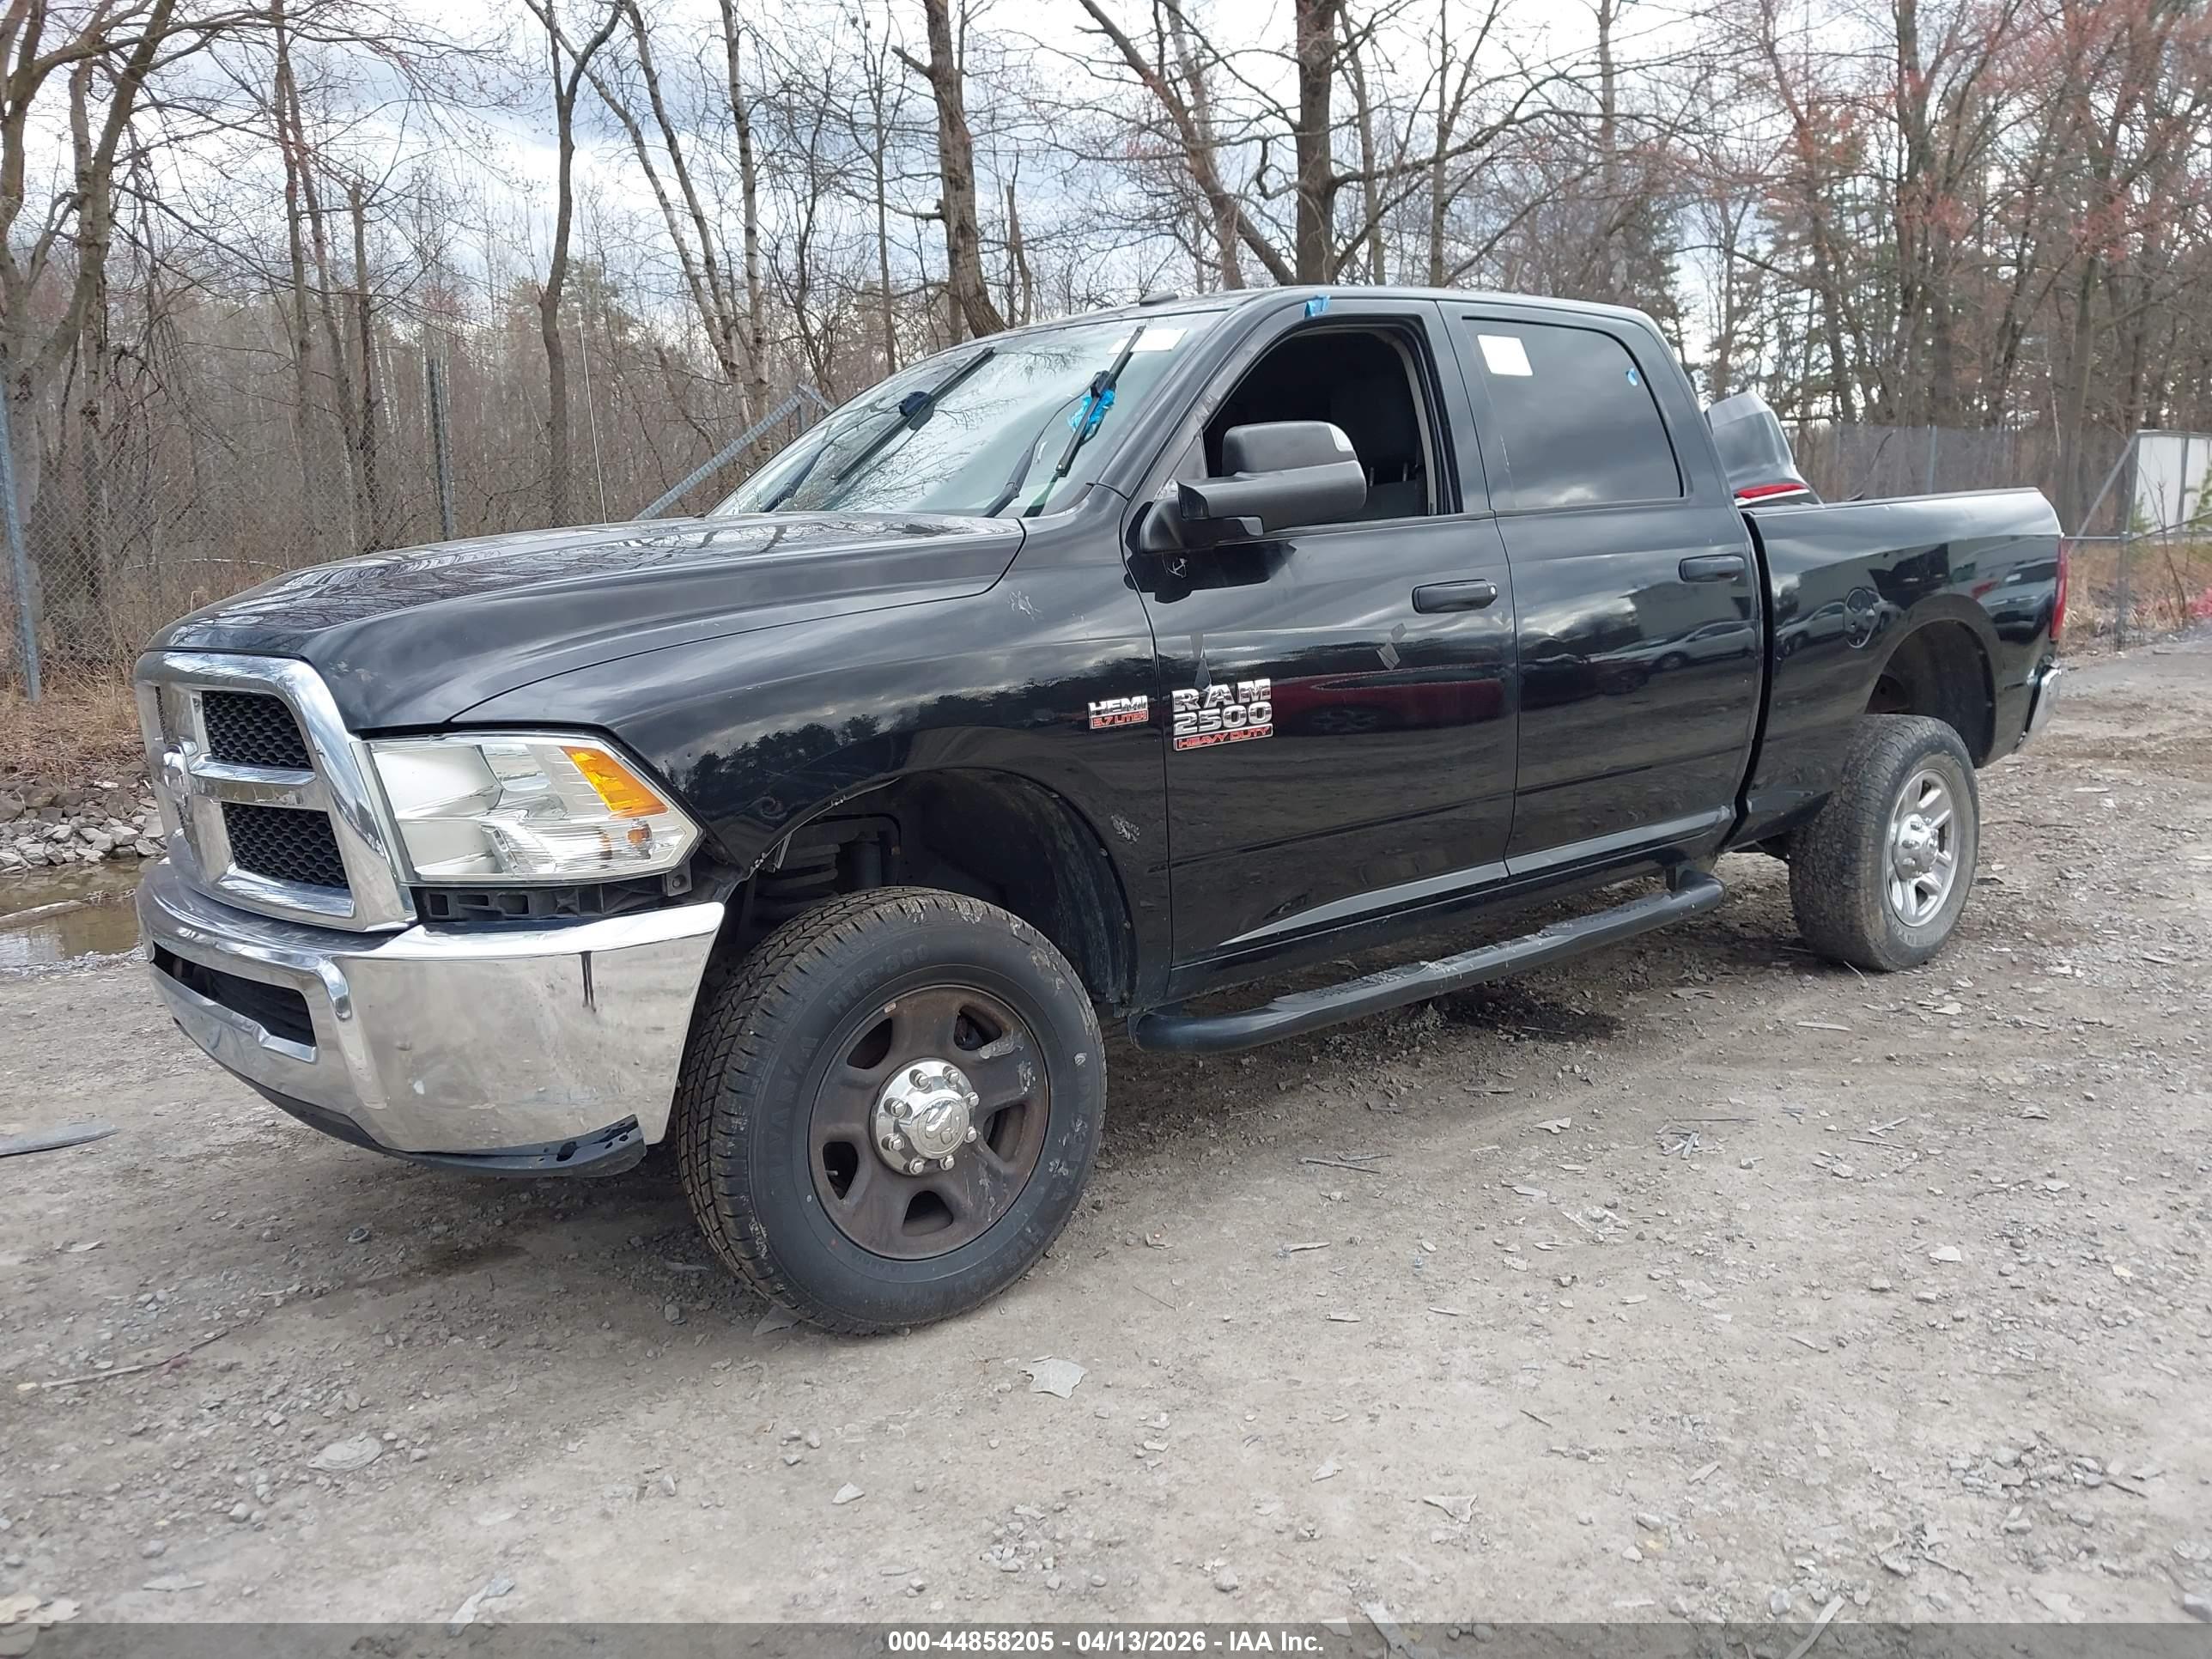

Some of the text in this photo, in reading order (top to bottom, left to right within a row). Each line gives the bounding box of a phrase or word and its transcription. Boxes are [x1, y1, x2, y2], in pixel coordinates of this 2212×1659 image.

[1088, 696, 1148, 716] HEMI
[1171, 678, 1272, 713] RAM
[1093, 710, 1146, 727] 5.7 LITER
[1173, 702, 1273, 736] 2500
[1179, 726, 1271, 748] HEAVY DUTY
